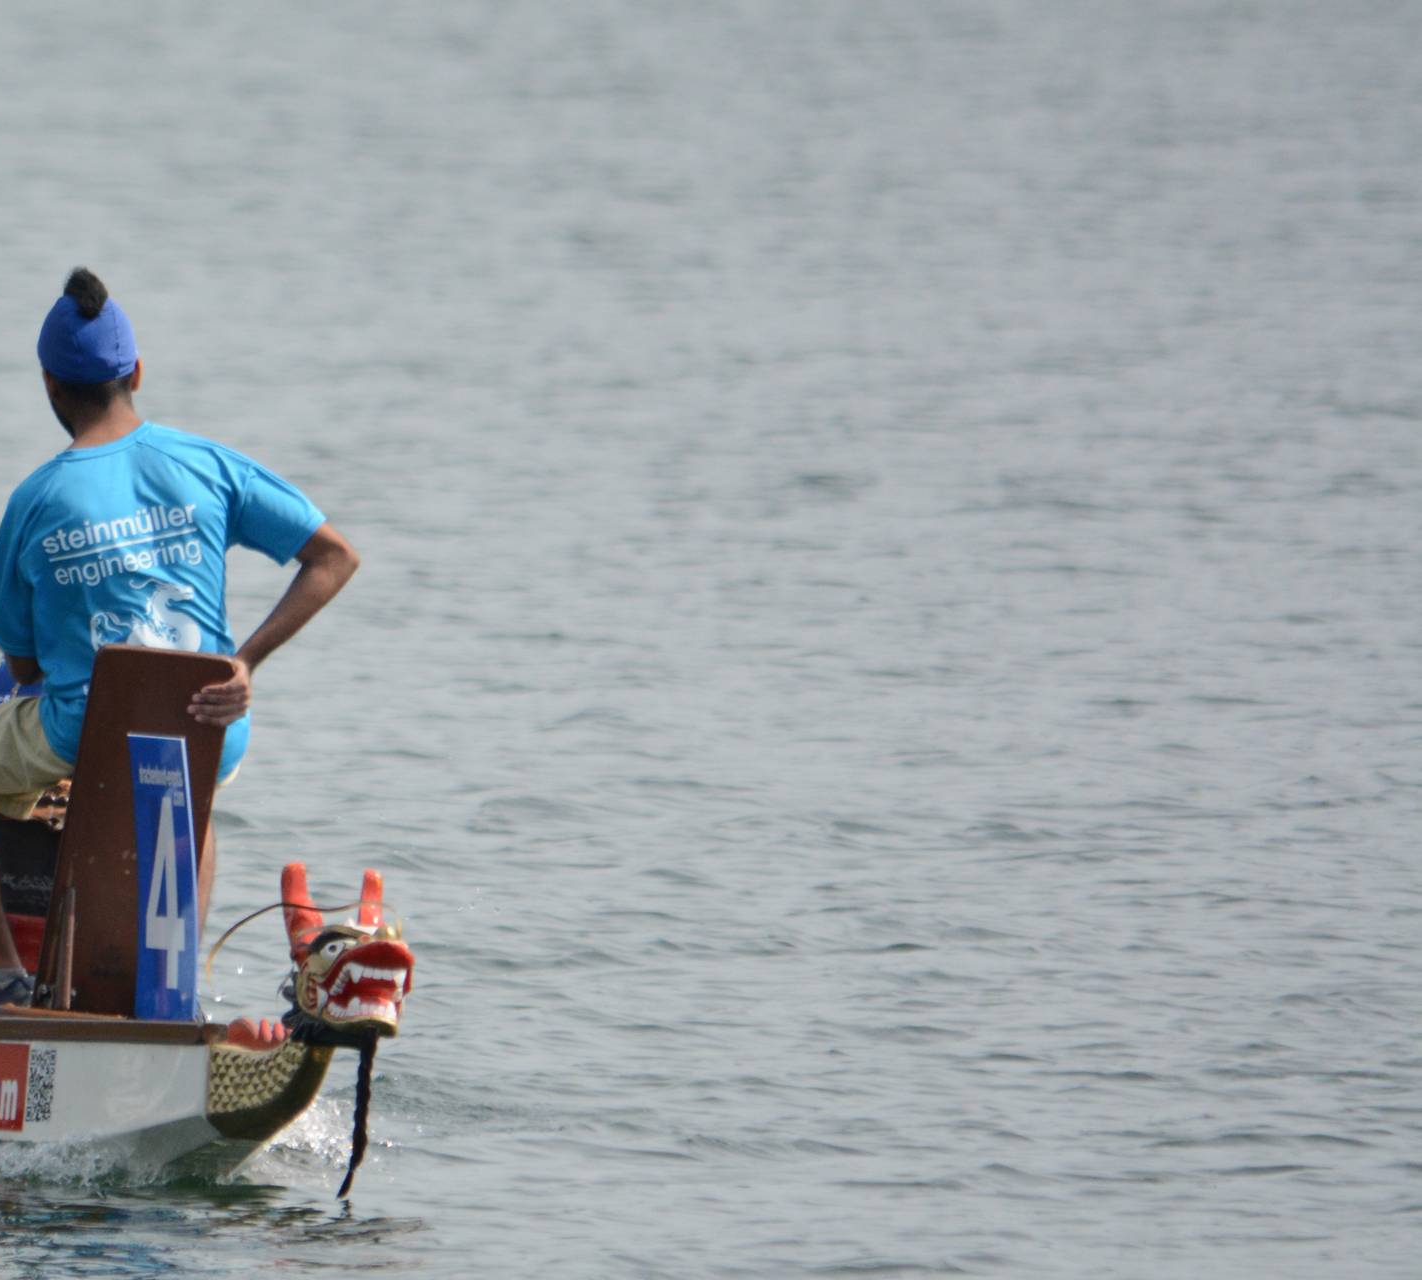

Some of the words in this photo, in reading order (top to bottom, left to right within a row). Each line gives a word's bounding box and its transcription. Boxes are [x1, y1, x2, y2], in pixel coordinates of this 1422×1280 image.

[42, 504, 196, 554] steinmüller
[54, 539, 202, 586] engineering
[146, 796, 185, 989] 4
